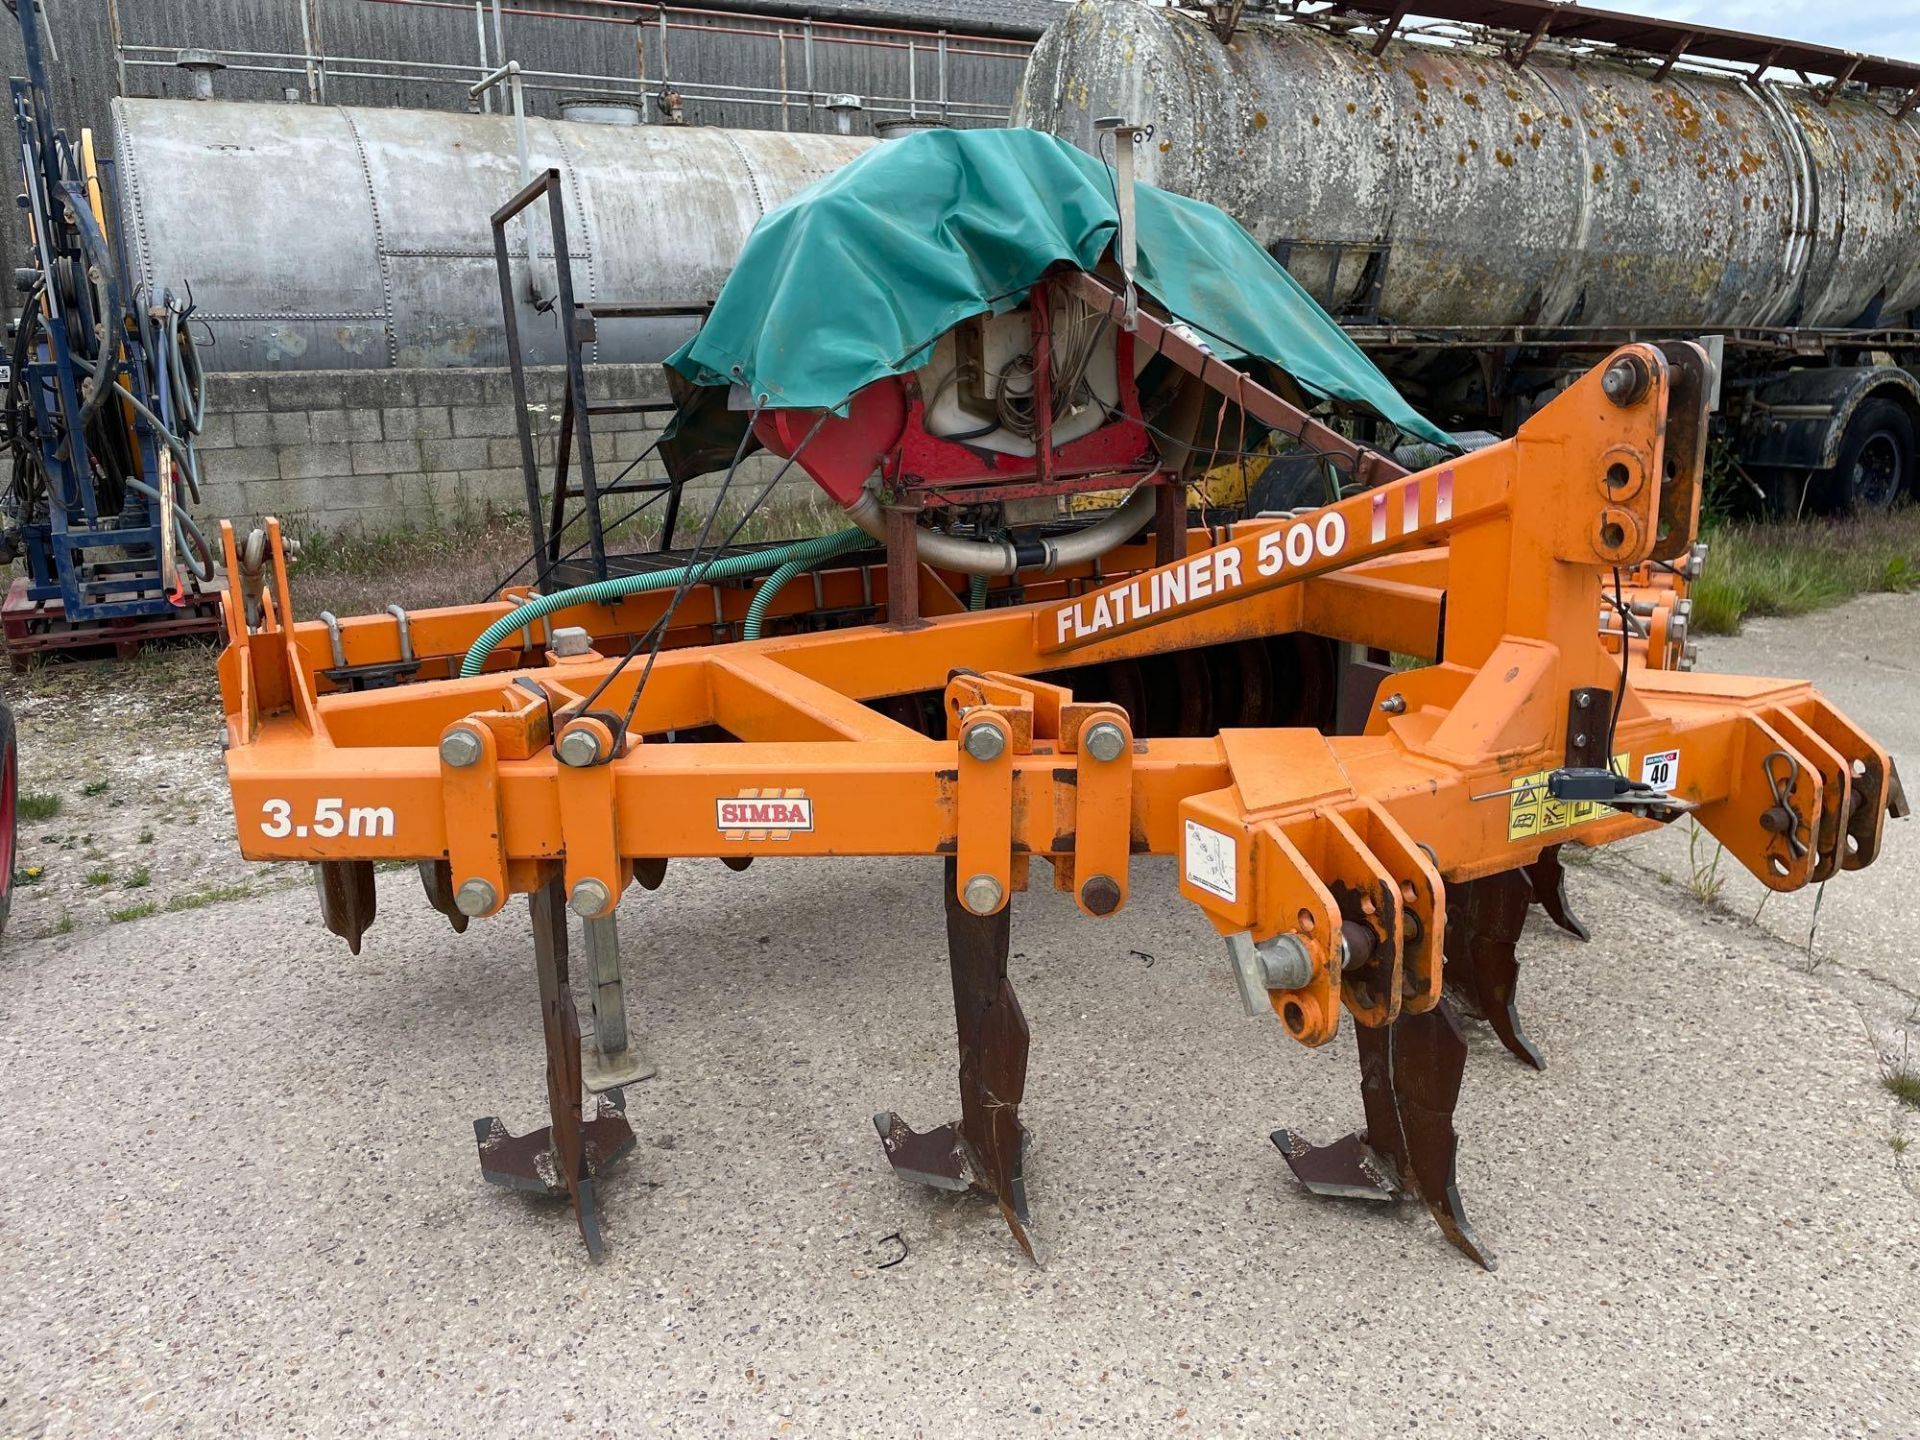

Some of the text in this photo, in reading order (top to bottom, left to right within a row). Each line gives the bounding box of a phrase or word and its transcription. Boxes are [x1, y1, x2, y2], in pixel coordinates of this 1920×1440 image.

[1057, 511, 1346, 643] FLATLINER 500
[1650, 762, 1669, 785] 40
[260, 797, 394, 838] 3.5m
[721, 803, 807, 823] SIMBA
